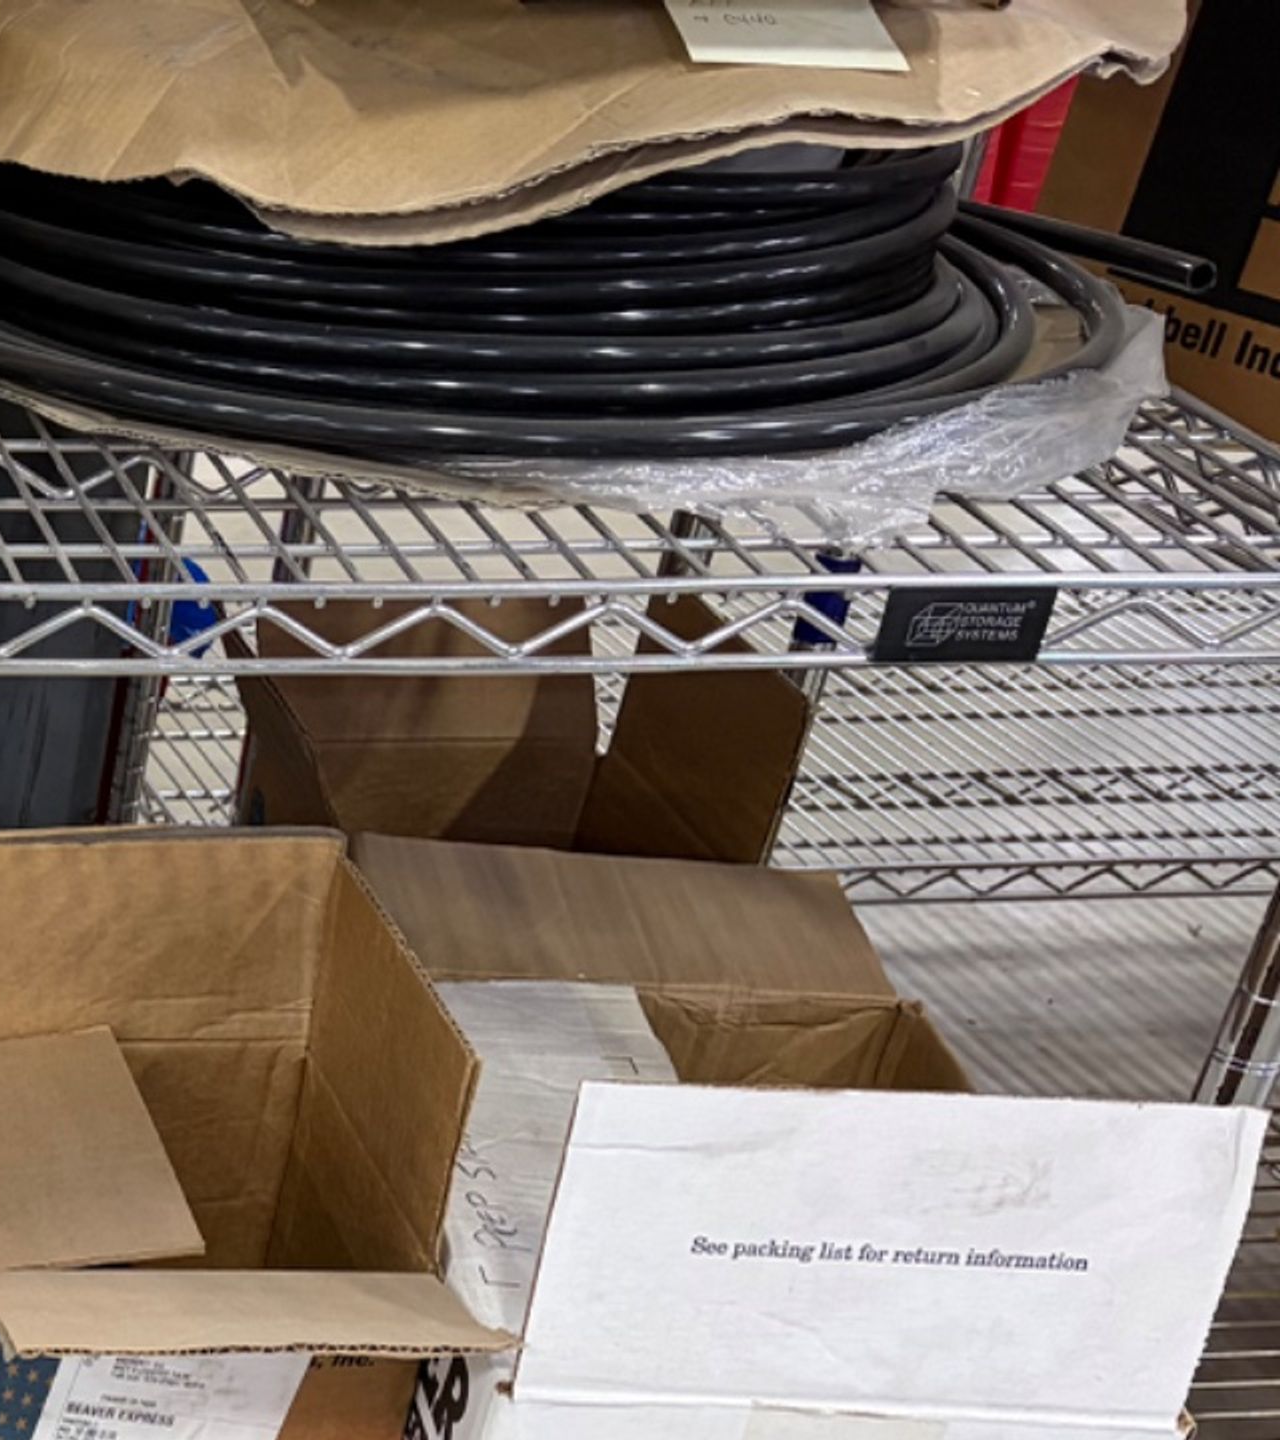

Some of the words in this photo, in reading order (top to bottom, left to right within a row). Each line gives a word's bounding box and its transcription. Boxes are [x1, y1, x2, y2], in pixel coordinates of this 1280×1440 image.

[1152, 299, 1227, 358] bell
[959, 616, 1023, 628] STORAGE
[954, 630, 1018, 641] SYSTEMS
[690, 1235, 728, 1255] See
[731, 1238, 815, 1263] packing
[818, 1241, 853, 1261] list
[857, 1243, 889, 1263] for
[892, 1246, 960, 1266] return
[964, 1248, 1089, 1272] information
